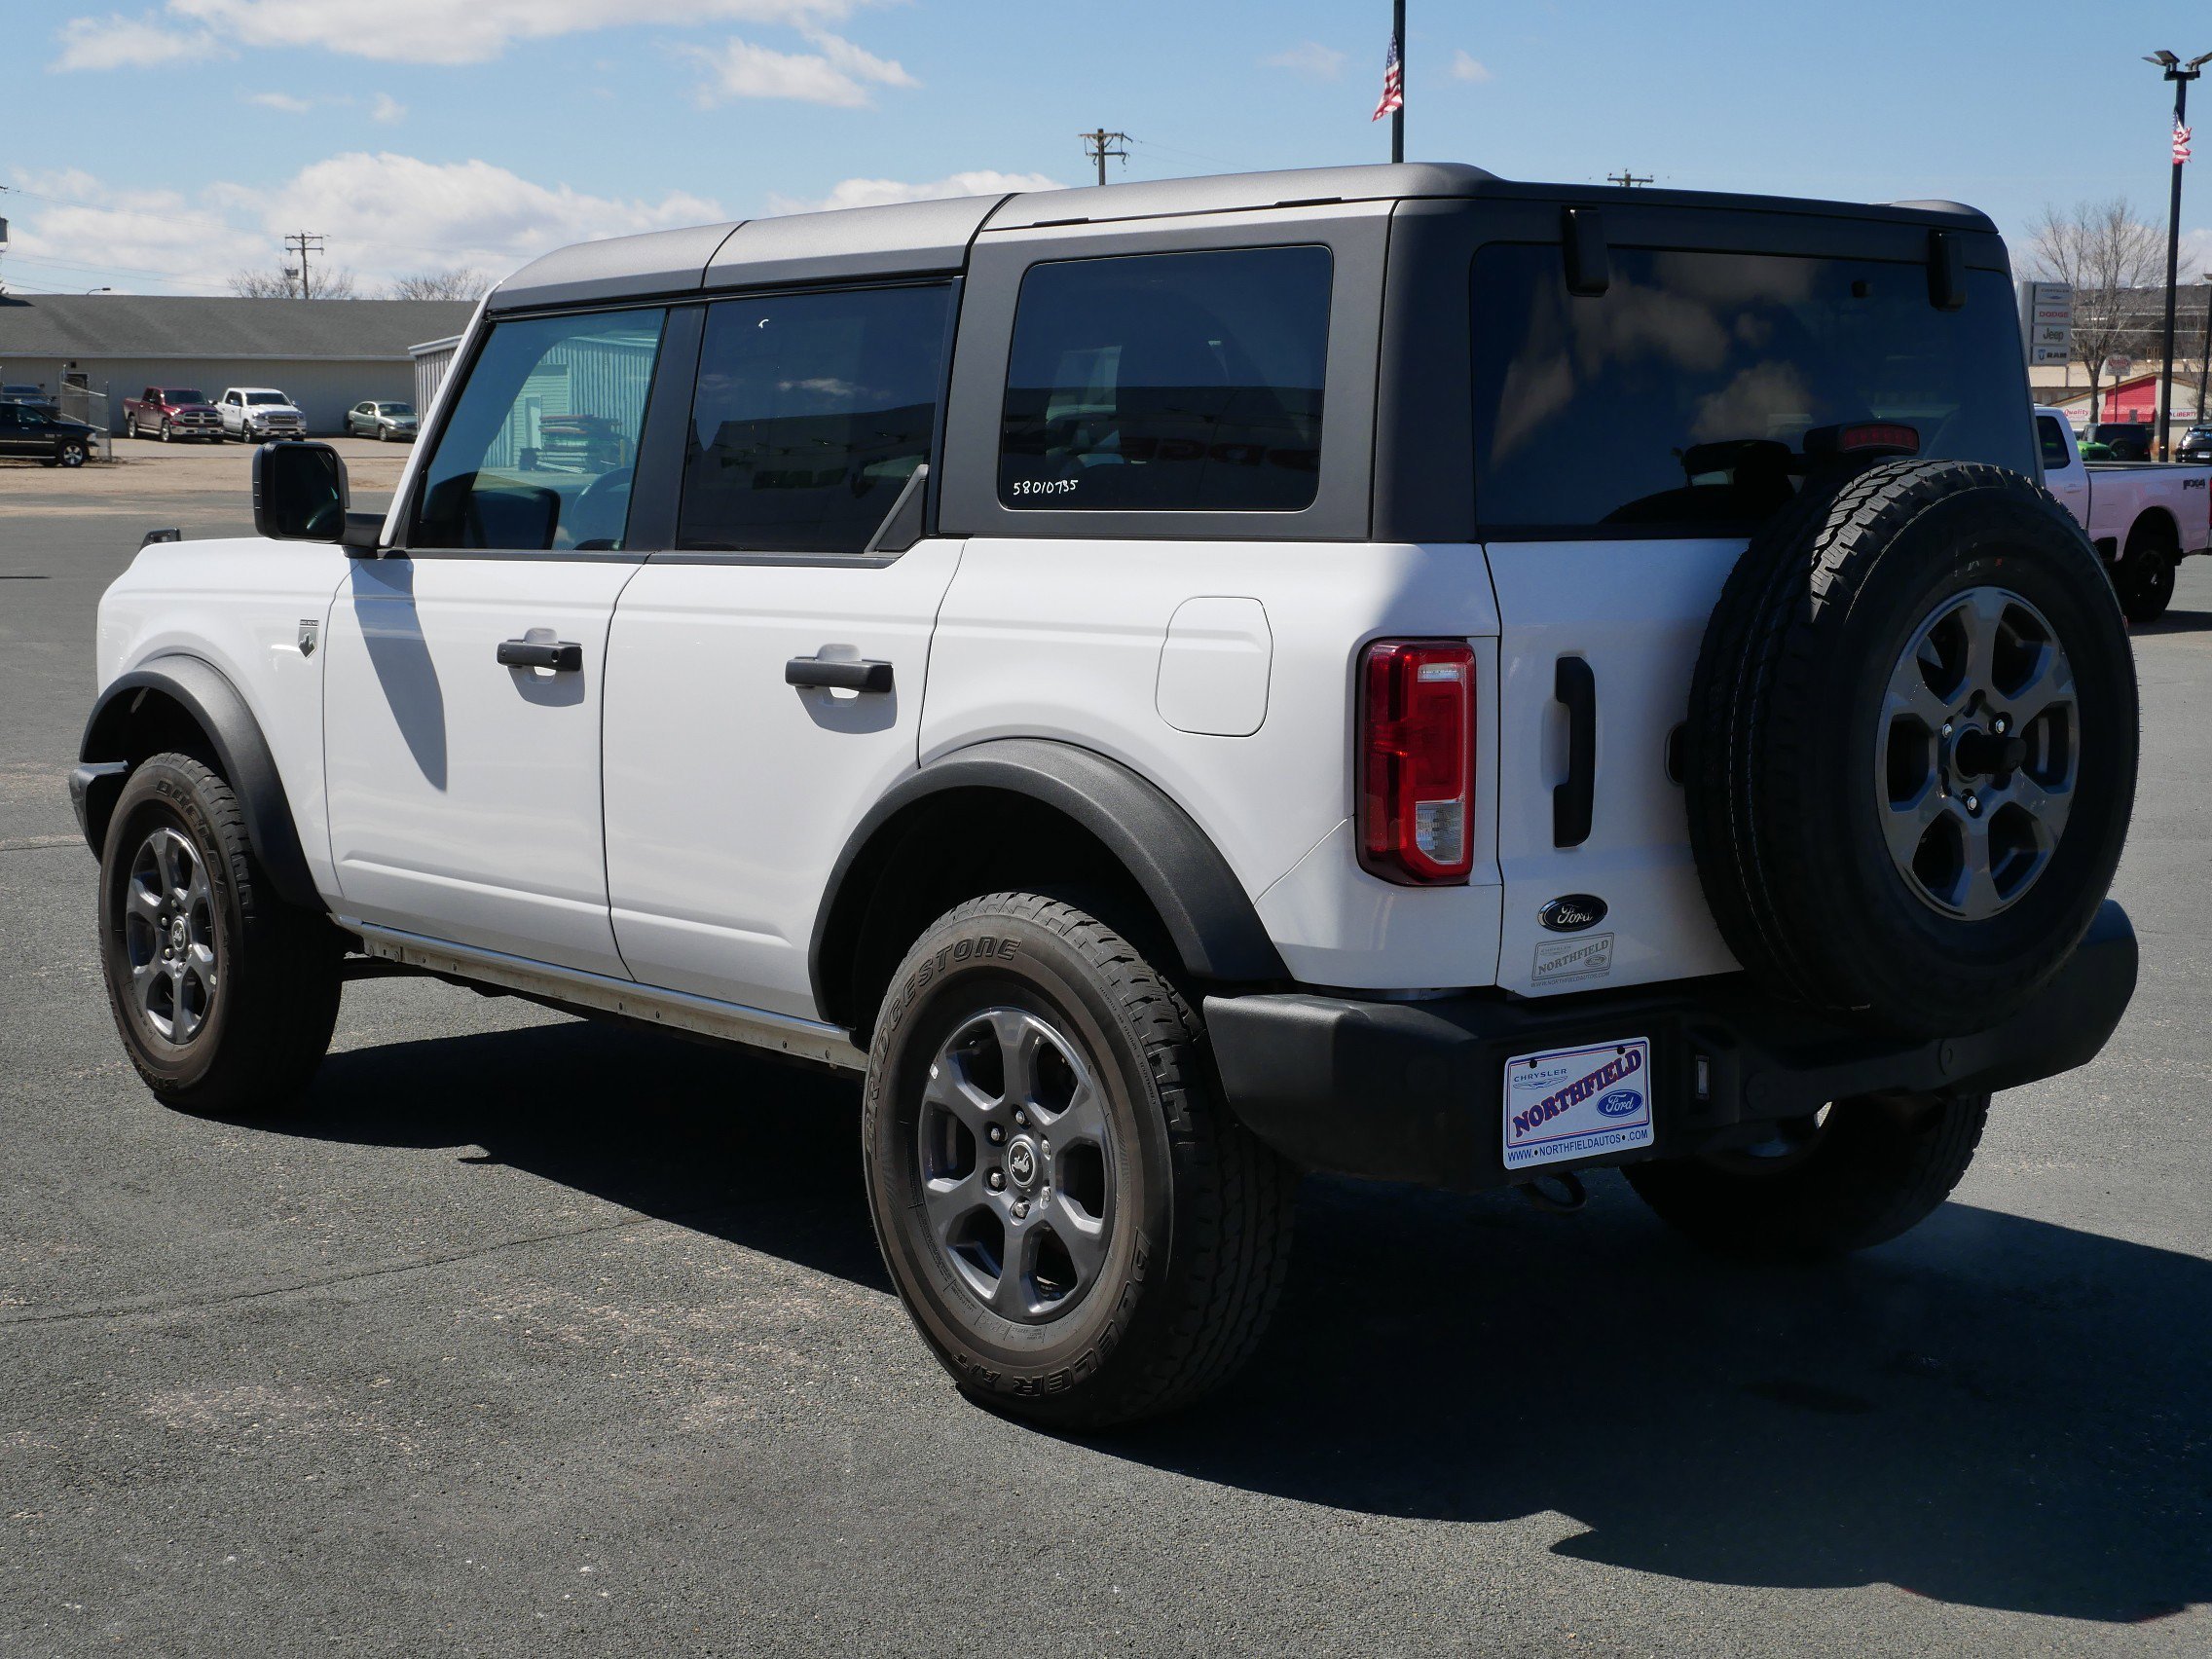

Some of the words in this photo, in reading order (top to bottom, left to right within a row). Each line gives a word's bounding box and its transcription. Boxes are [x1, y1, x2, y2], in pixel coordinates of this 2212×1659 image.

[2043, 327, 2064, 342] Jeep
[2064, 408, 2089, 417] Quality
[1557, 903, 1594, 924] Ford
[1537, 939, 1609, 976] NORTHFIELD
[865, 935, 1023, 1160] BRIDGESTONE
[1513, 1068, 1567, 1083] CHRYSLER
[1512, 1049, 1642, 1138] NORTHFIELD
[1605, 1093, 1635, 1113] Ford
